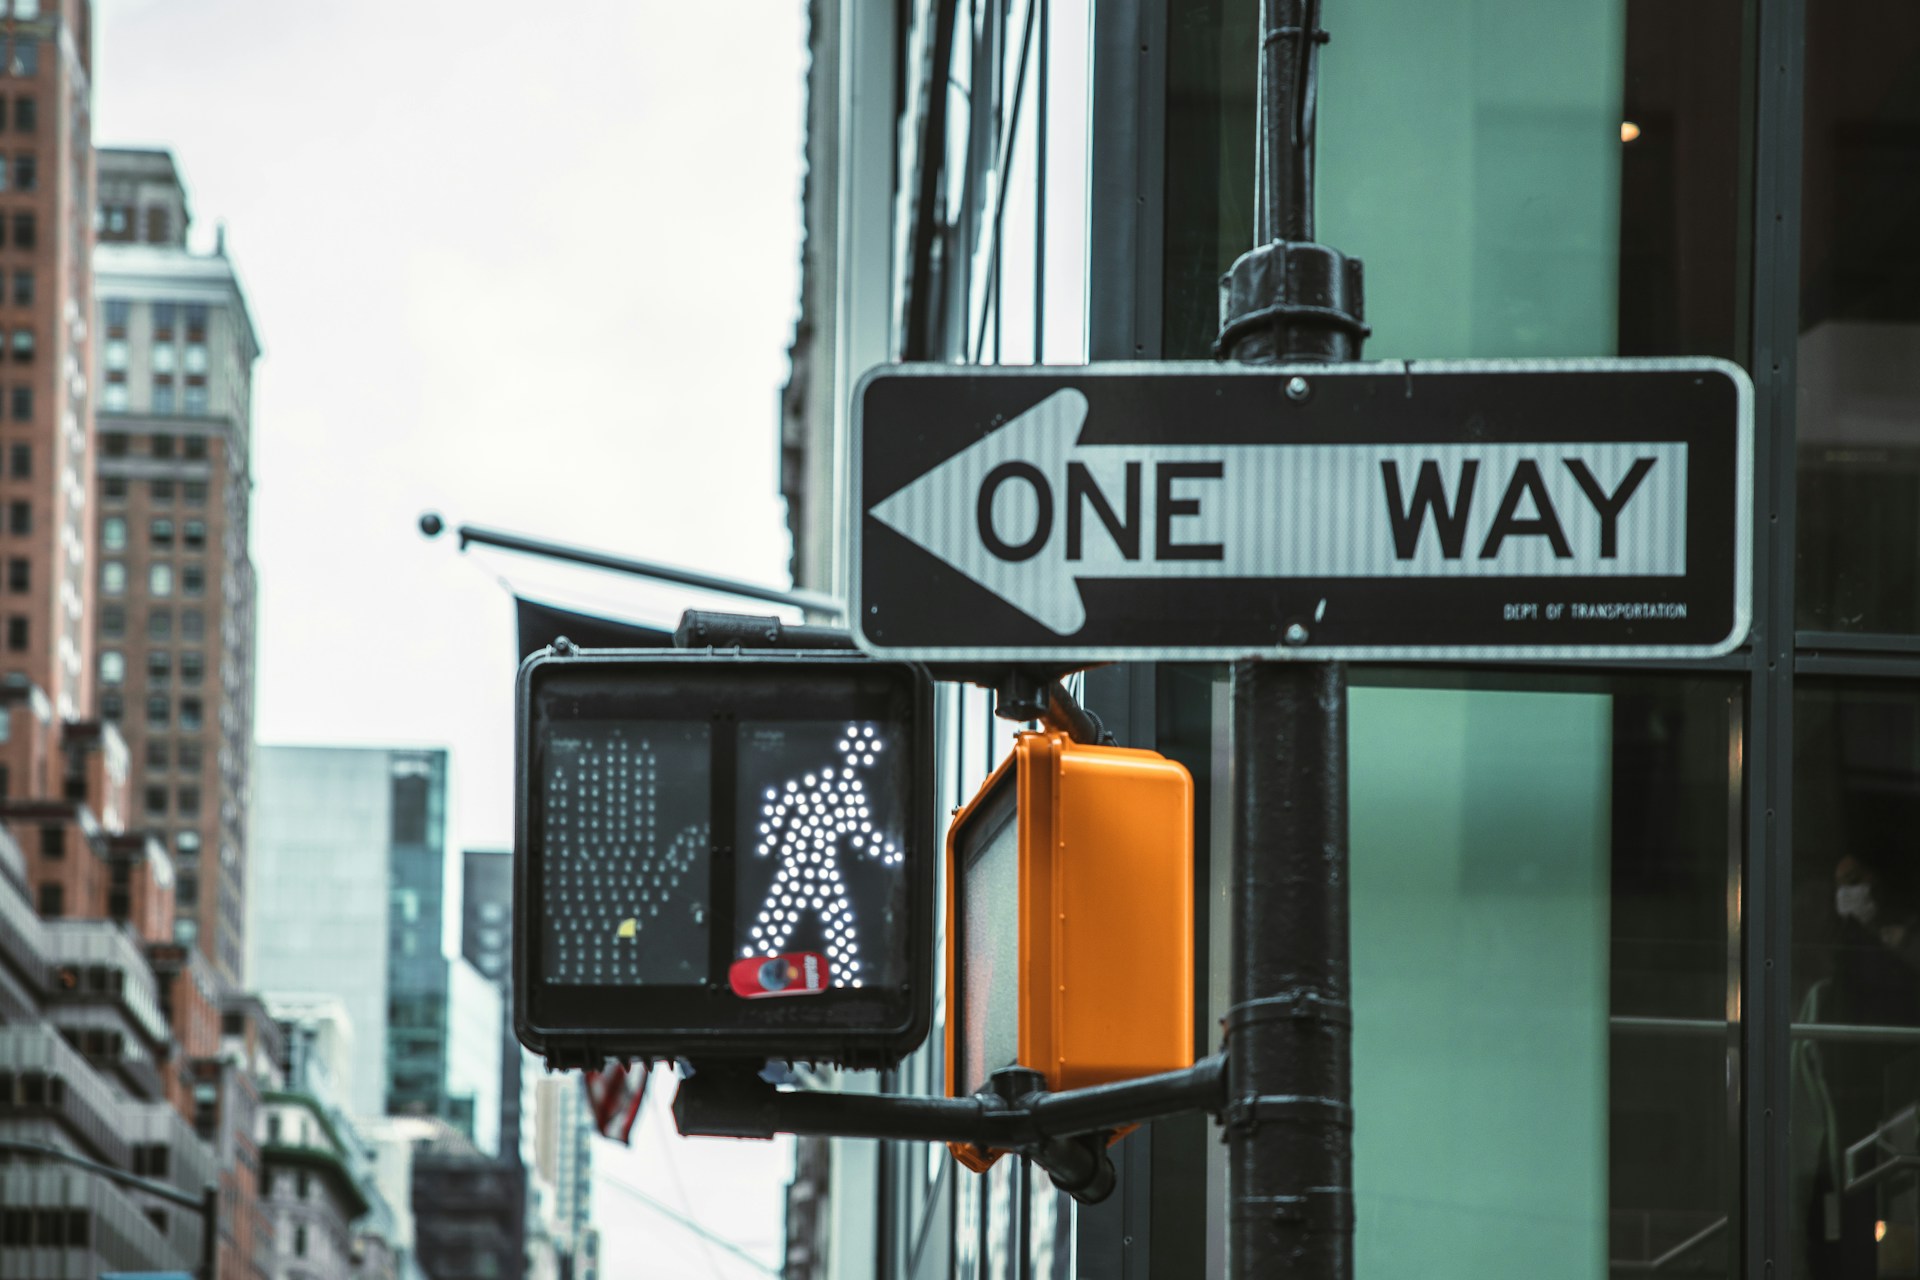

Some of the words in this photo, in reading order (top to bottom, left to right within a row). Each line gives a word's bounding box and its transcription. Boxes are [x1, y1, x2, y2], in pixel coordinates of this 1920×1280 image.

[976, 459, 1225, 563] ONE
[1380, 457, 1658, 561] WAY
[1503, 602, 1539, 621] DEPT
[1546, 602, 1565, 620] OF
[1571, 602, 1688, 619] TRANSPORTATION
